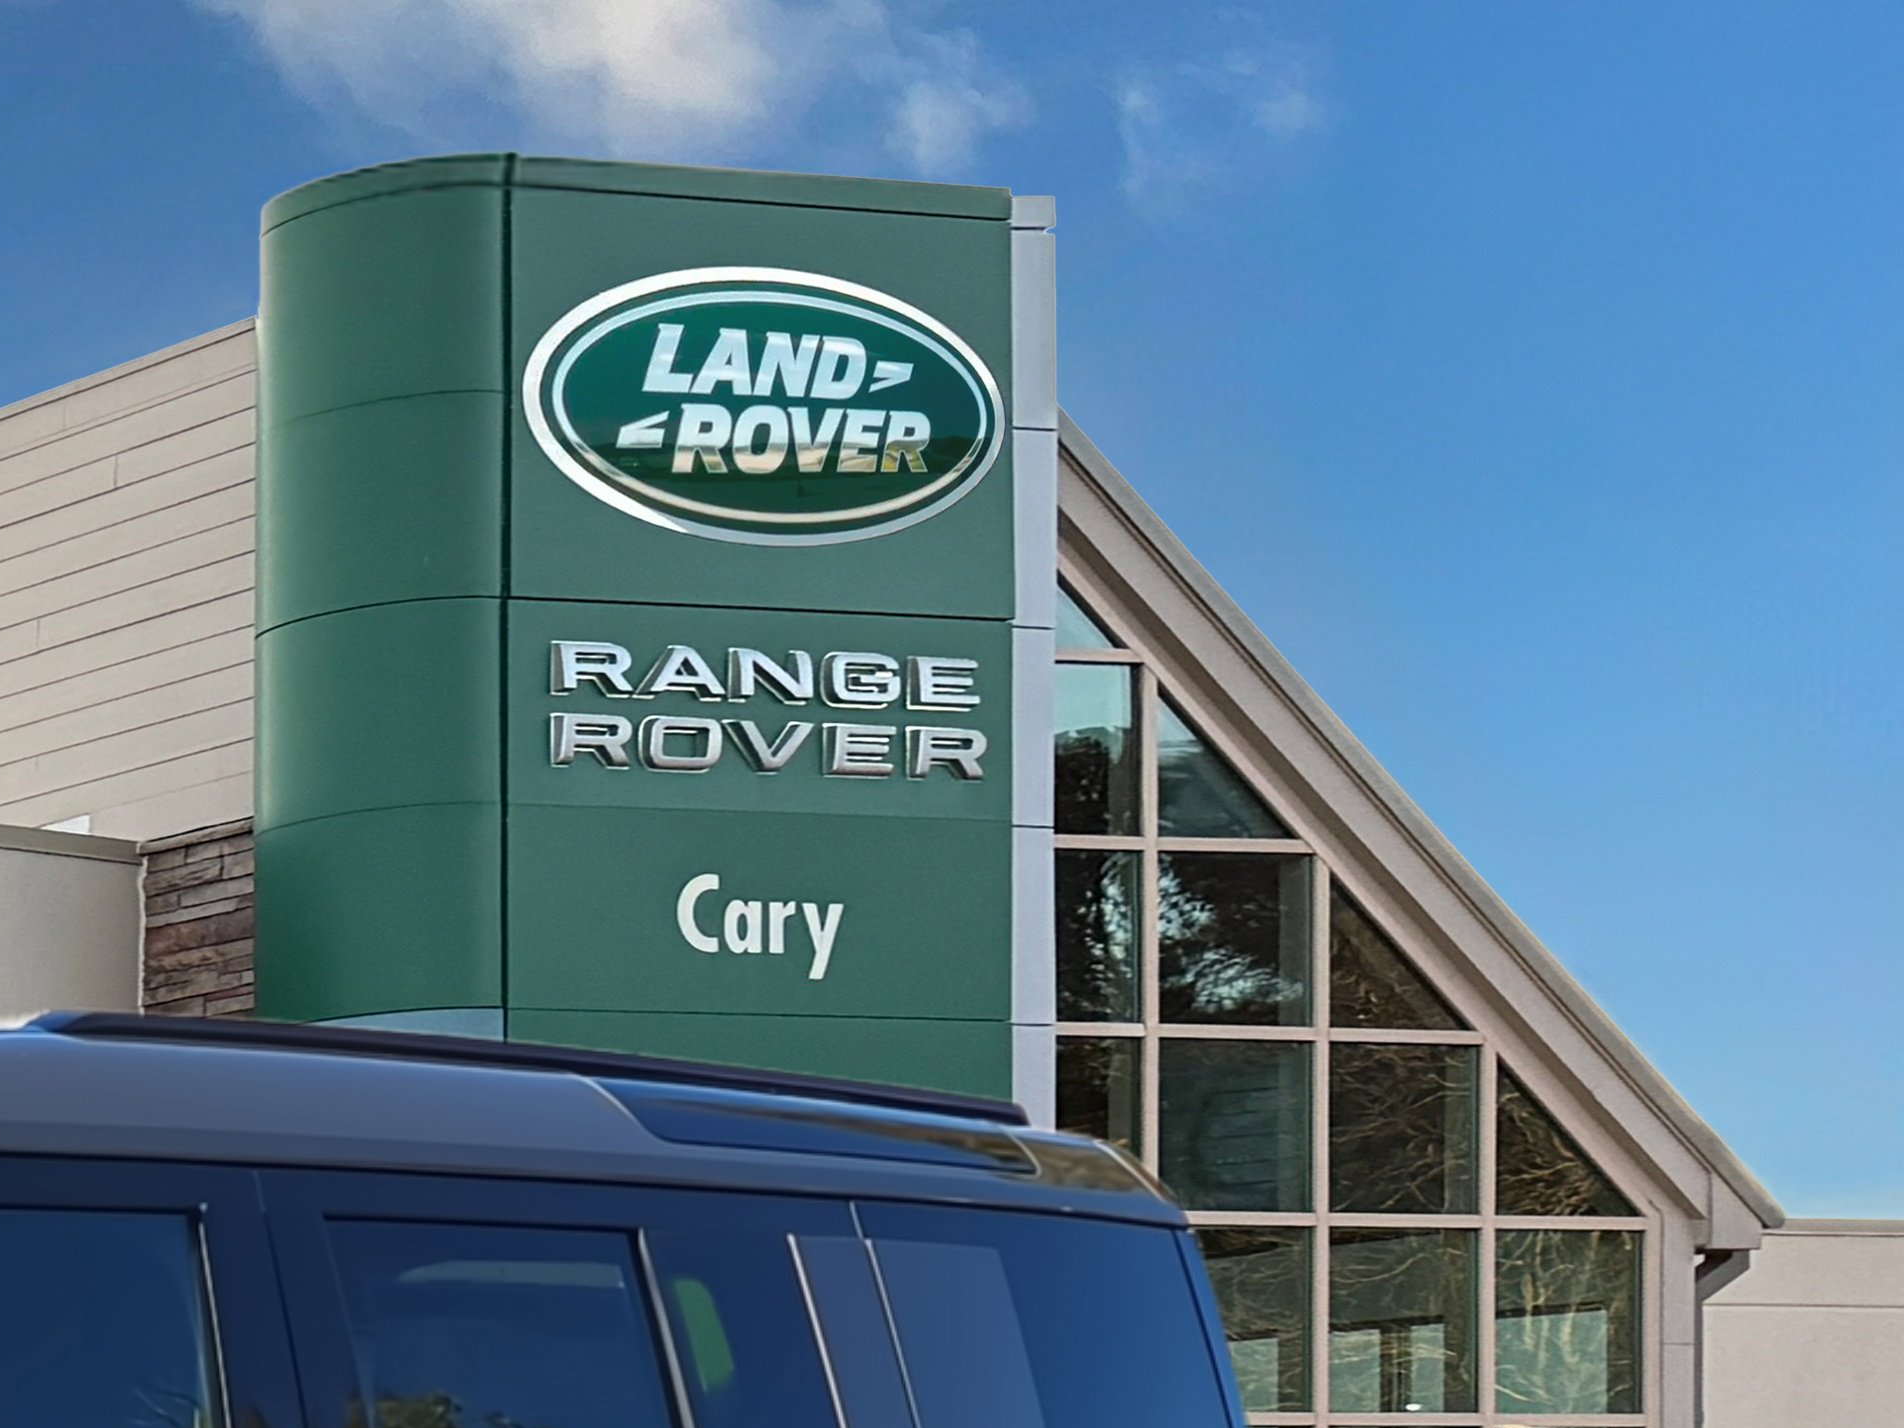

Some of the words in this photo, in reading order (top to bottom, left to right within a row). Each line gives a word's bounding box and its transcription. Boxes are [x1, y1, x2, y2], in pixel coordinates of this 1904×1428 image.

[641, 322, 870, 400] LAND
[670, 403, 931, 475] ROVER
[549, 640, 982, 711] RANGE
[549, 711, 988, 781] ROVER
[676, 872, 845, 981] Cary
